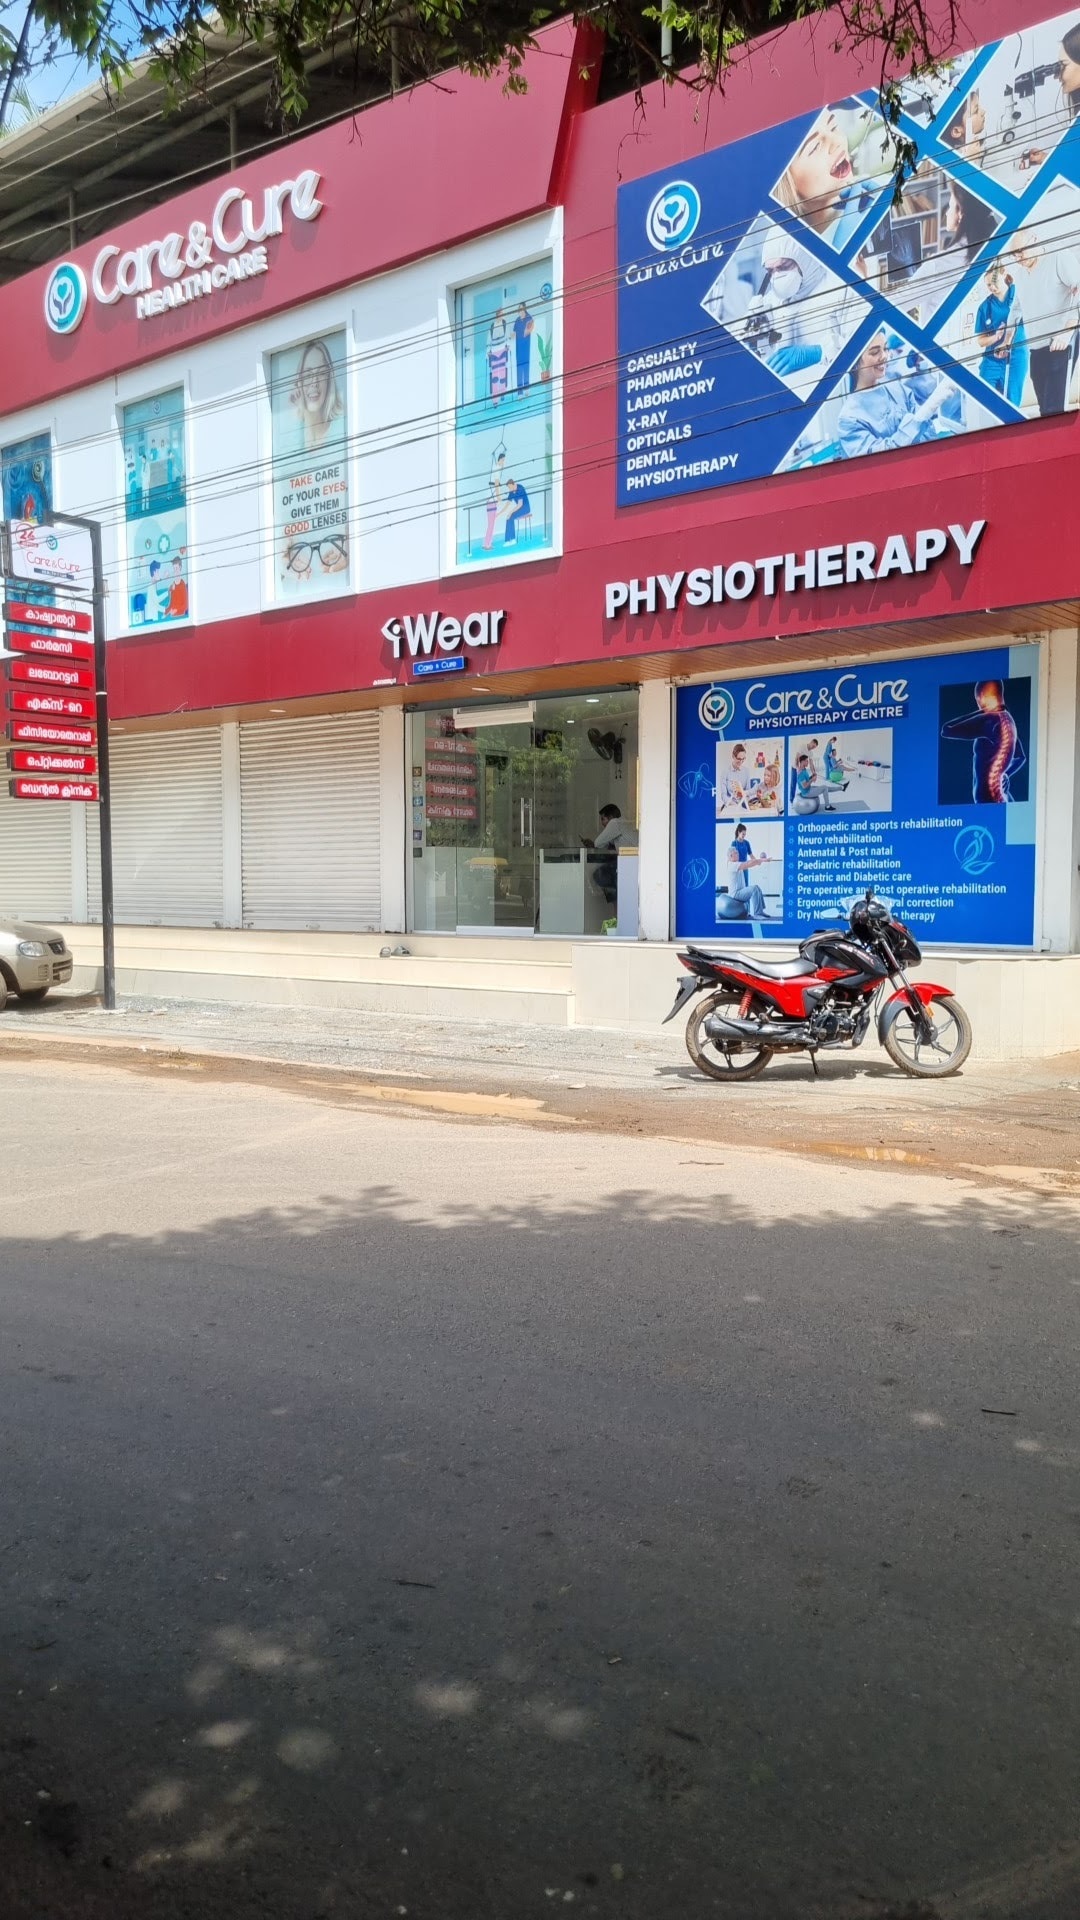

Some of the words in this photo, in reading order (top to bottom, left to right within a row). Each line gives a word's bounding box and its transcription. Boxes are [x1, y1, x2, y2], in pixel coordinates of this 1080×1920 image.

[627, 341, 697, 373] CASUALTY
[627, 360, 703, 393] PHARMACY
[627, 377, 716, 412] LABORATORY
[627, 410, 668, 432] X-RAY
[627, 424, 692, 452] OPTICALS
[626, 449, 677, 471] DENTAL
[290, 474, 313, 489] TAKE
[315, 467, 340, 482] CARE
[626, 453, 739, 491] PHYSIOTHERAPY
[282, 494, 294, 506] OF
[296, 488, 320, 502] YOUR
[291, 506, 312, 519] GIVE
[314, 498, 340, 514] THEM
[284, 521, 310, 535] GOOD
[312, 512, 348, 529] LENSES
[605, 519, 988, 619] PHYSIOTHERAPY
[417, 664, 434, 672] Care
[441, 661, 457, 669] Cure
[749, 710, 849, 730] PHYSIOTHERAPY
[852, 705, 903, 720] CENTRE
[797, 821, 849, 834] Orthopaedic
[852, 820, 868, 831] and
[870, 819, 899, 832] sports
[901, 817, 963, 829] rehabilitation
[797, 835, 823, 845] Neuro
[824, 833, 883, 845] rehabilitation
[797, 847, 838, 858] Antenatal
[840, 847, 846, 857] &
[849, 846, 869, 857] Post
[871, 845, 893, 856] natal
[797, 860, 840, 870] Paediatric
[842, 858, 901, 869] rehabilitation
[797, 872, 834, 882] Geriatric
[836, 872, 852, 882] and
[854, 871, 890, 882] Diabetic
[892, 872, 912, 881] care
[797, 885, 812, 895] Pre
[813, 885, 854, 896] operative
[873, 884, 894, 894] Post
[896, 884, 940, 896] operative
[941, 883, 1007, 894] rehabilitation
[906, 897, 954, 908] correction
[797, 909, 811, 922] Dry
[901, 910, 936, 923] therapy
